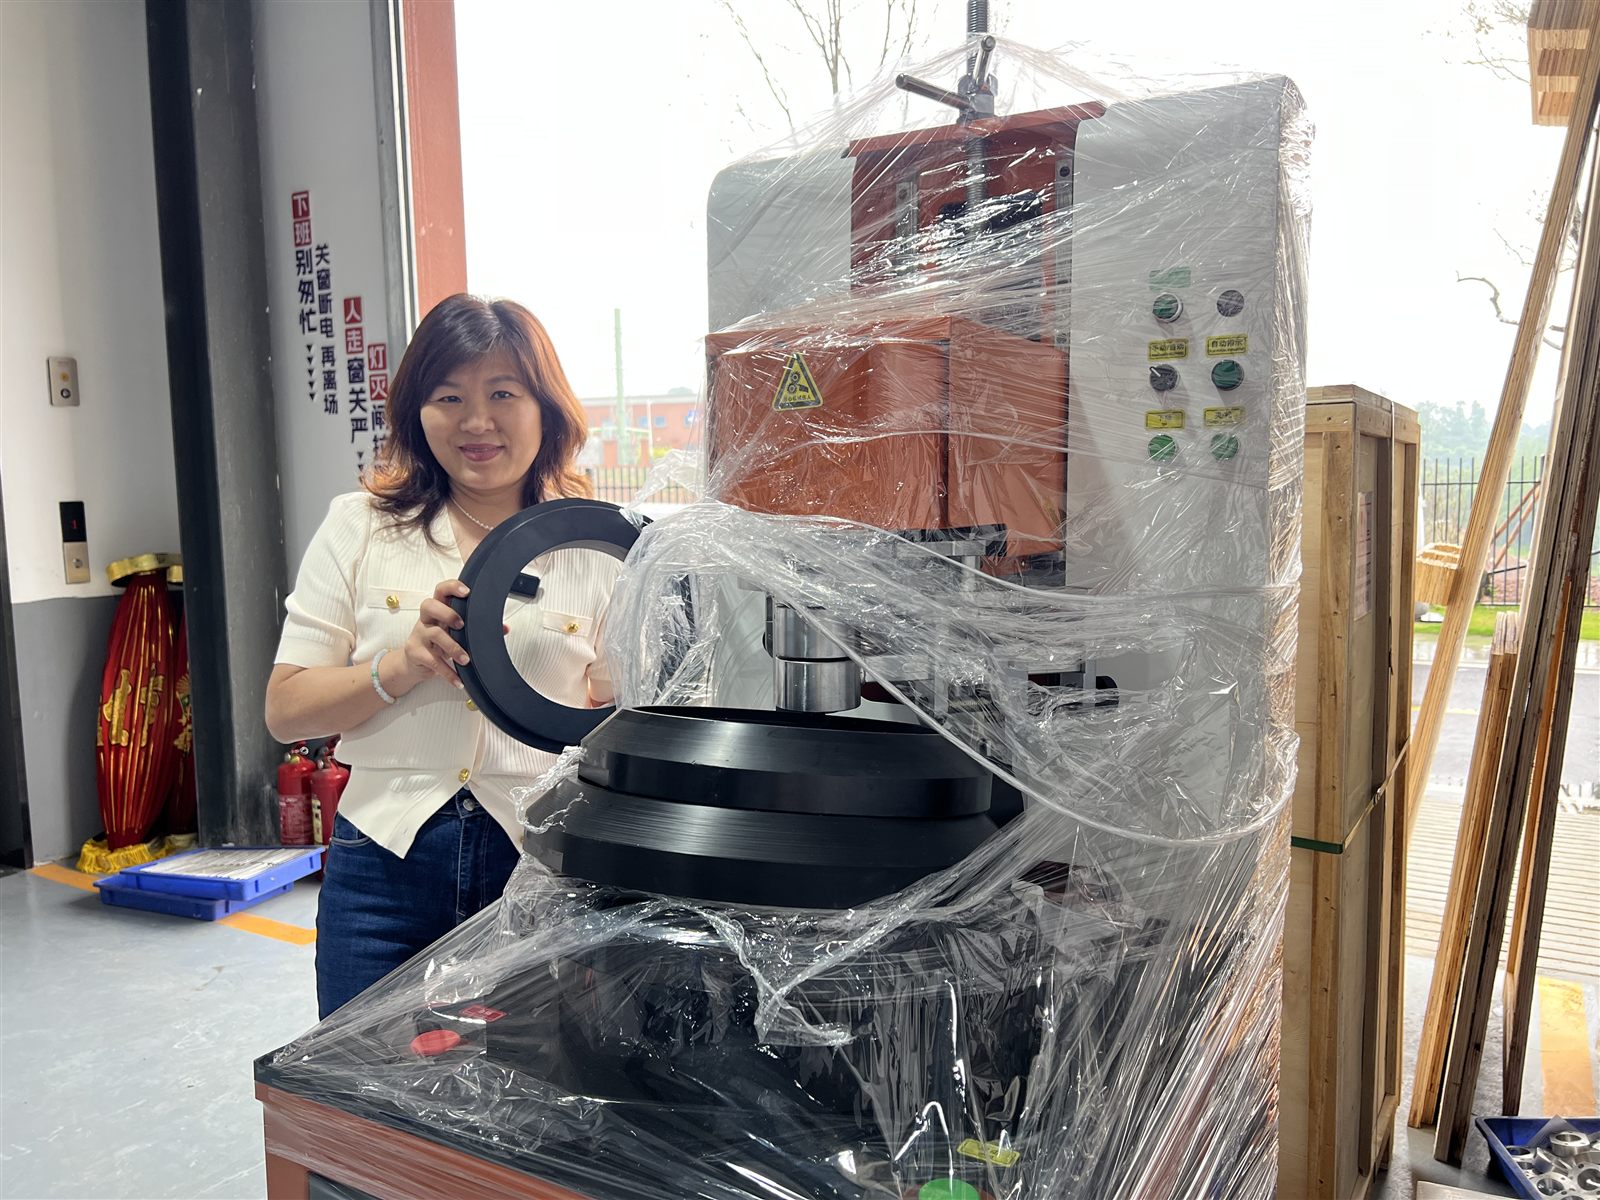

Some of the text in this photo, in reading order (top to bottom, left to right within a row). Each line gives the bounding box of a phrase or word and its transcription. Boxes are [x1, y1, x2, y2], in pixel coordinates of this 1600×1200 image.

[293, 192, 317, 335] 下班别匆忙
[315, 244, 338, 415] 关窗断电再离场
[345, 298, 368, 443] 人走窗关严
